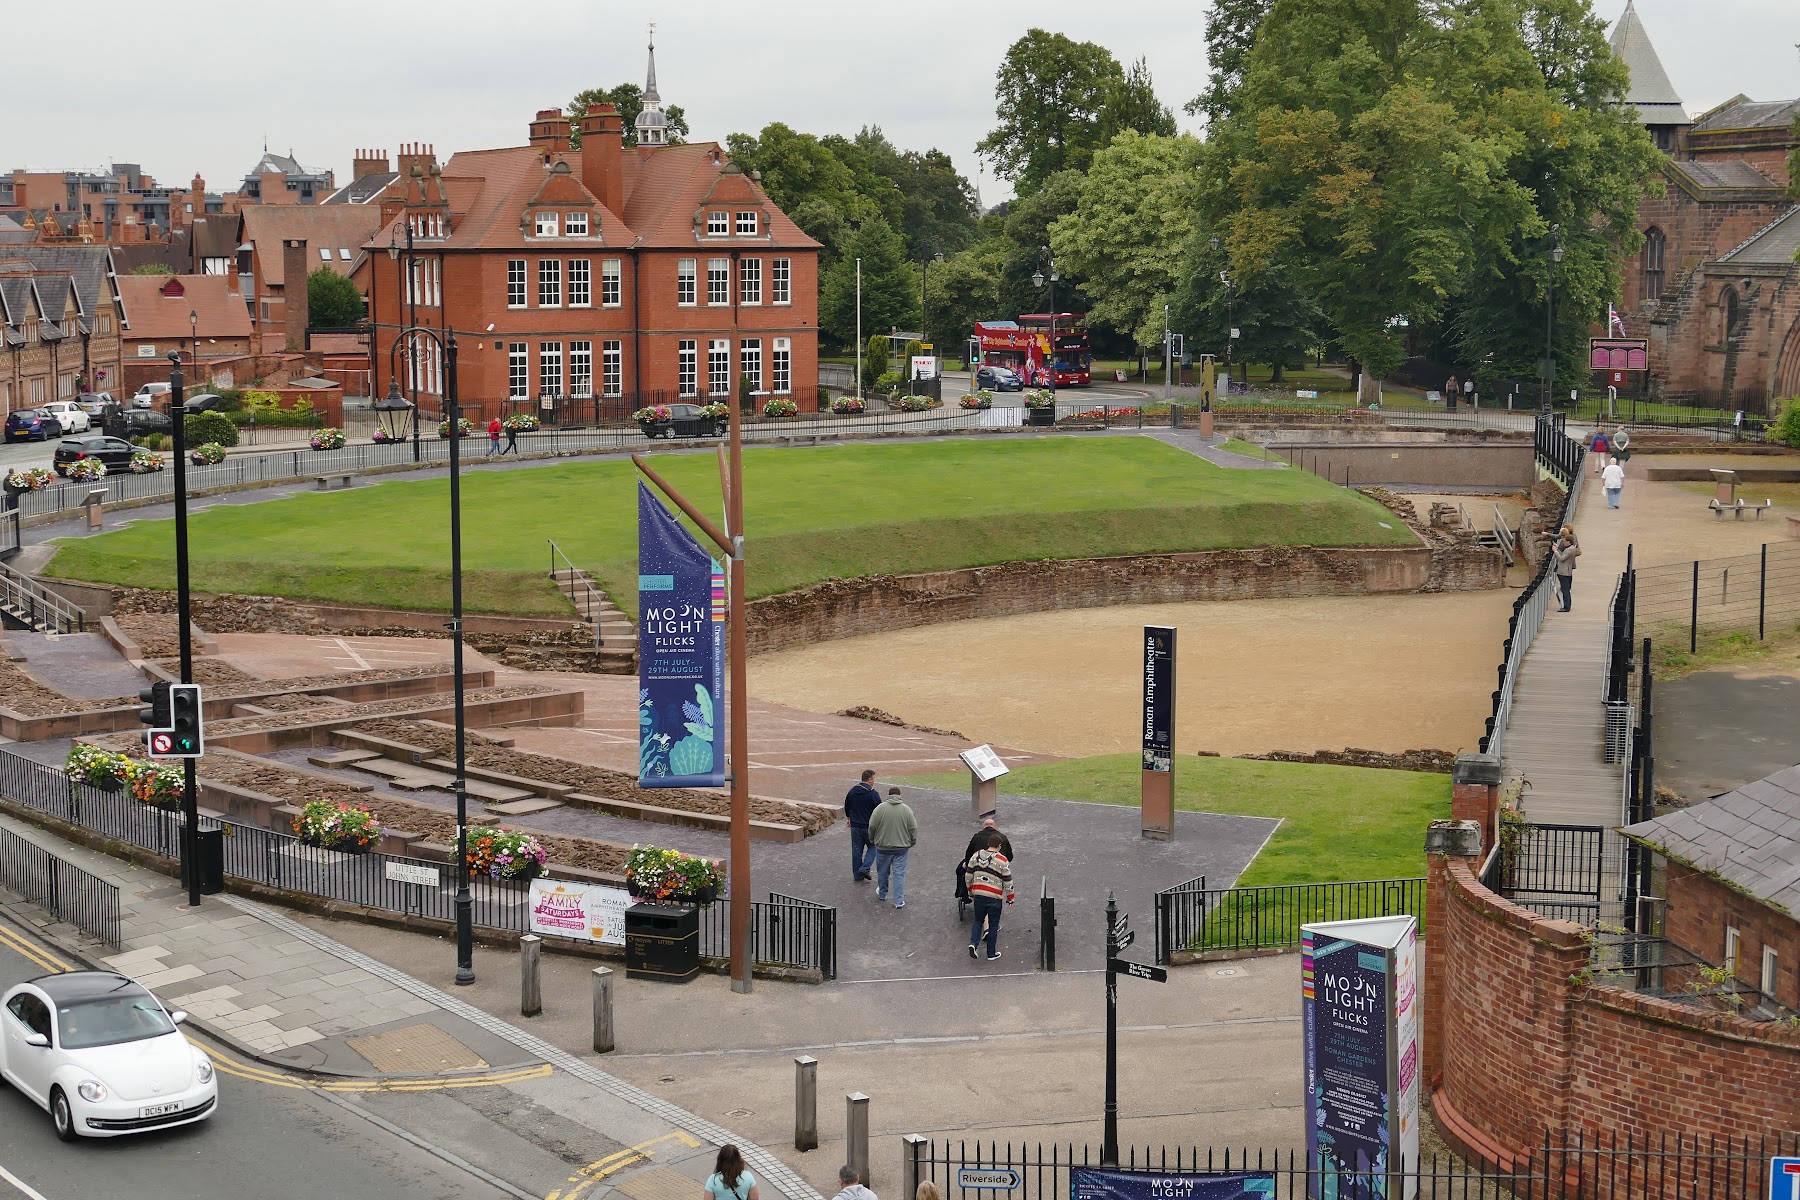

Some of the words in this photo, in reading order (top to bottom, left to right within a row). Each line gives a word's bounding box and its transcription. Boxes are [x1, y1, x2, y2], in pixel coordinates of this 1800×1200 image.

[646, 605, 704, 620] MOON
[648, 621, 702, 634] LIGHT
[656, 637, 695, 646] FLICKS
[1146, 637, 1157, 704] Amphitheatre
[1145, 706, 1153, 740] Roman
[395, 864, 417, 874] LITTLE
[388, 872, 409, 881] JOHNS
[412, 876, 436, 885] STREET
[542, 896, 580, 908] FAMILY
[540, 906, 580, 917] SATURDAYS
[613, 922, 625, 931] JUL
[607, 930, 625, 938] AUG
[1324, 973, 1376, 998] MOON
[1326, 988, 1375, 1013] LIGHT
[1333, 1009, 1368, 1026] FLICKS
[1330, 1038, 1345, 1047] 29TH
[1346, 1041, 1369, 1053] AUGUST
[1325, 1046, 1345, 1057] ROMAN
[1348, 1051, 1376, 1065] GARDENS
[1337, 1057, 1363, 1068] CHESTER
[145, 1107, 162, 1116] DC15
[164, 1104, 178, 1112] WFM
[962, 1175, 1008, 1183] Riverside
[1151, 1178, 1193, 1189] MOON
[1152, 1188, 1192, 1197] LIGHT
